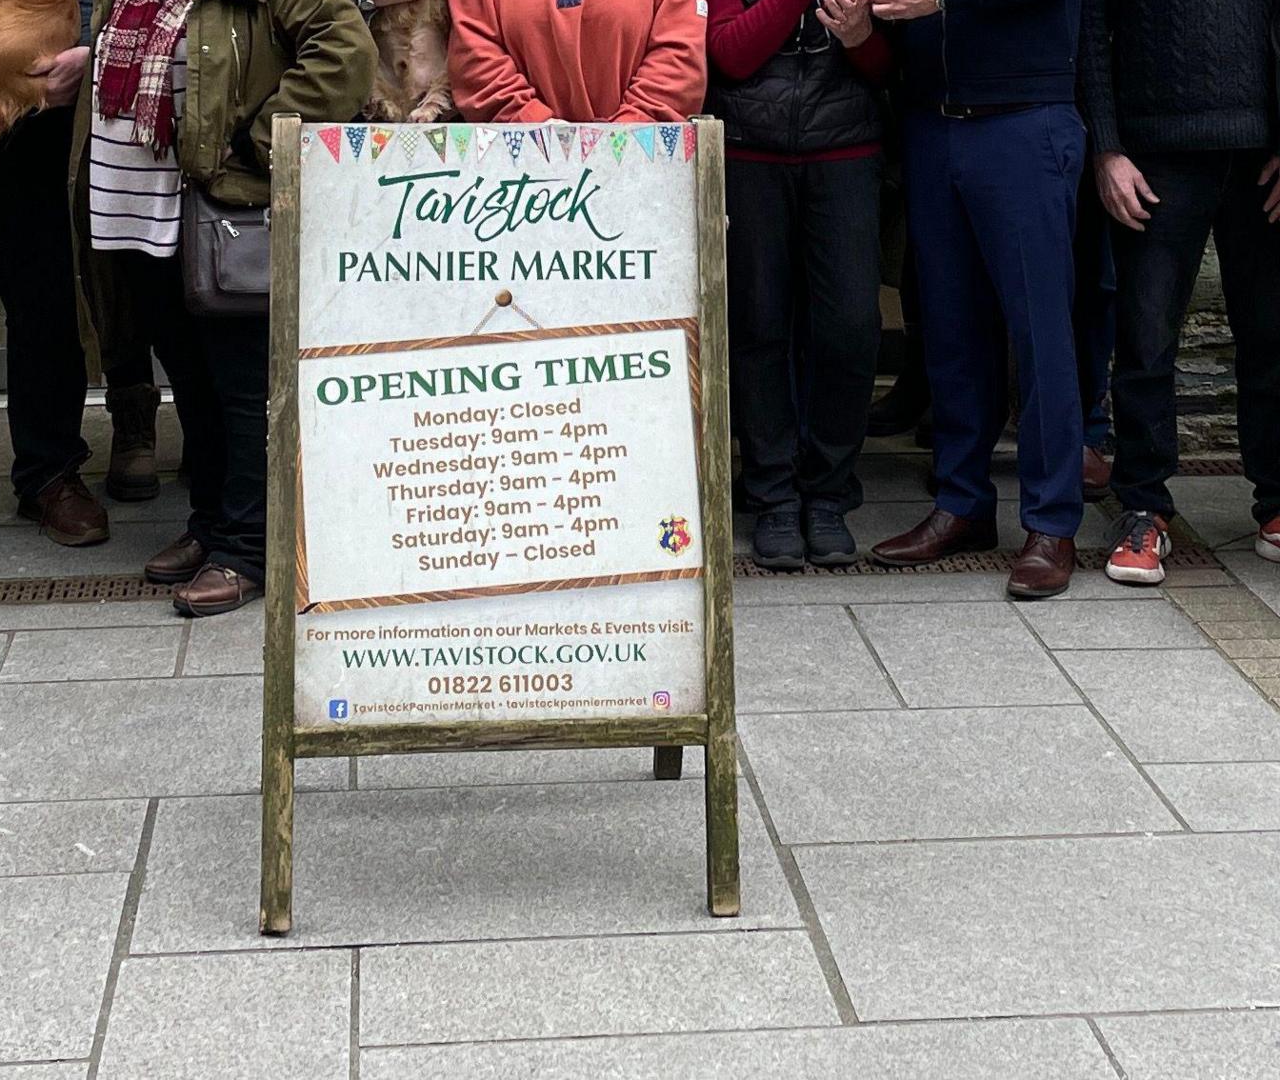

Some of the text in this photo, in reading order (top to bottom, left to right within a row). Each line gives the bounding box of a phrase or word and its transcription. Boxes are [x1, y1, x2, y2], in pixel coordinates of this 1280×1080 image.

[378, 168, 623, 241] Tavistock
[339, 249, 657, 282] PANNIER MARKET
[317, 350, 671, 406] OPENING TIMES
[414, 398, 581, 428] Monday: Closed
[390, 430, 487, 453] Tuesday:
[492, 427, 538, 444] 9am
[560, 421, 608, 442] 4pm
[373, 453, 506, 479] Wednesday:
[511, 450, 558, 467] 9am
[580, 443, 628, 465] 4pm
[388, 477, 494, 502] Thursday:
[499, 474, 546, 491] 9am
[569, 467, 617, 488] 4pm
[406, 503, 479, 525] Friday:
[484, 499, 531, 516] 9am
[554, 492, 601, 514] 4pm
[392, 525, 497, 550] Saturday:
[501, 522, 549, 539] 9am
[571, 515, 619, 537] 4pm
[419, 551, 499, 573] Sunday
[524, 539, 596, 560] Closed
[307, 621, 693, 641] For more information on our Markets & Events visit:
[343, 643, 647, 668] WWW.TAVISTOCK.GOV.UK
[428, 673, 573, 695] 01822 611003
[353, 696, 647, 714] TavistockPannierMarket tavistockpanniermarket
